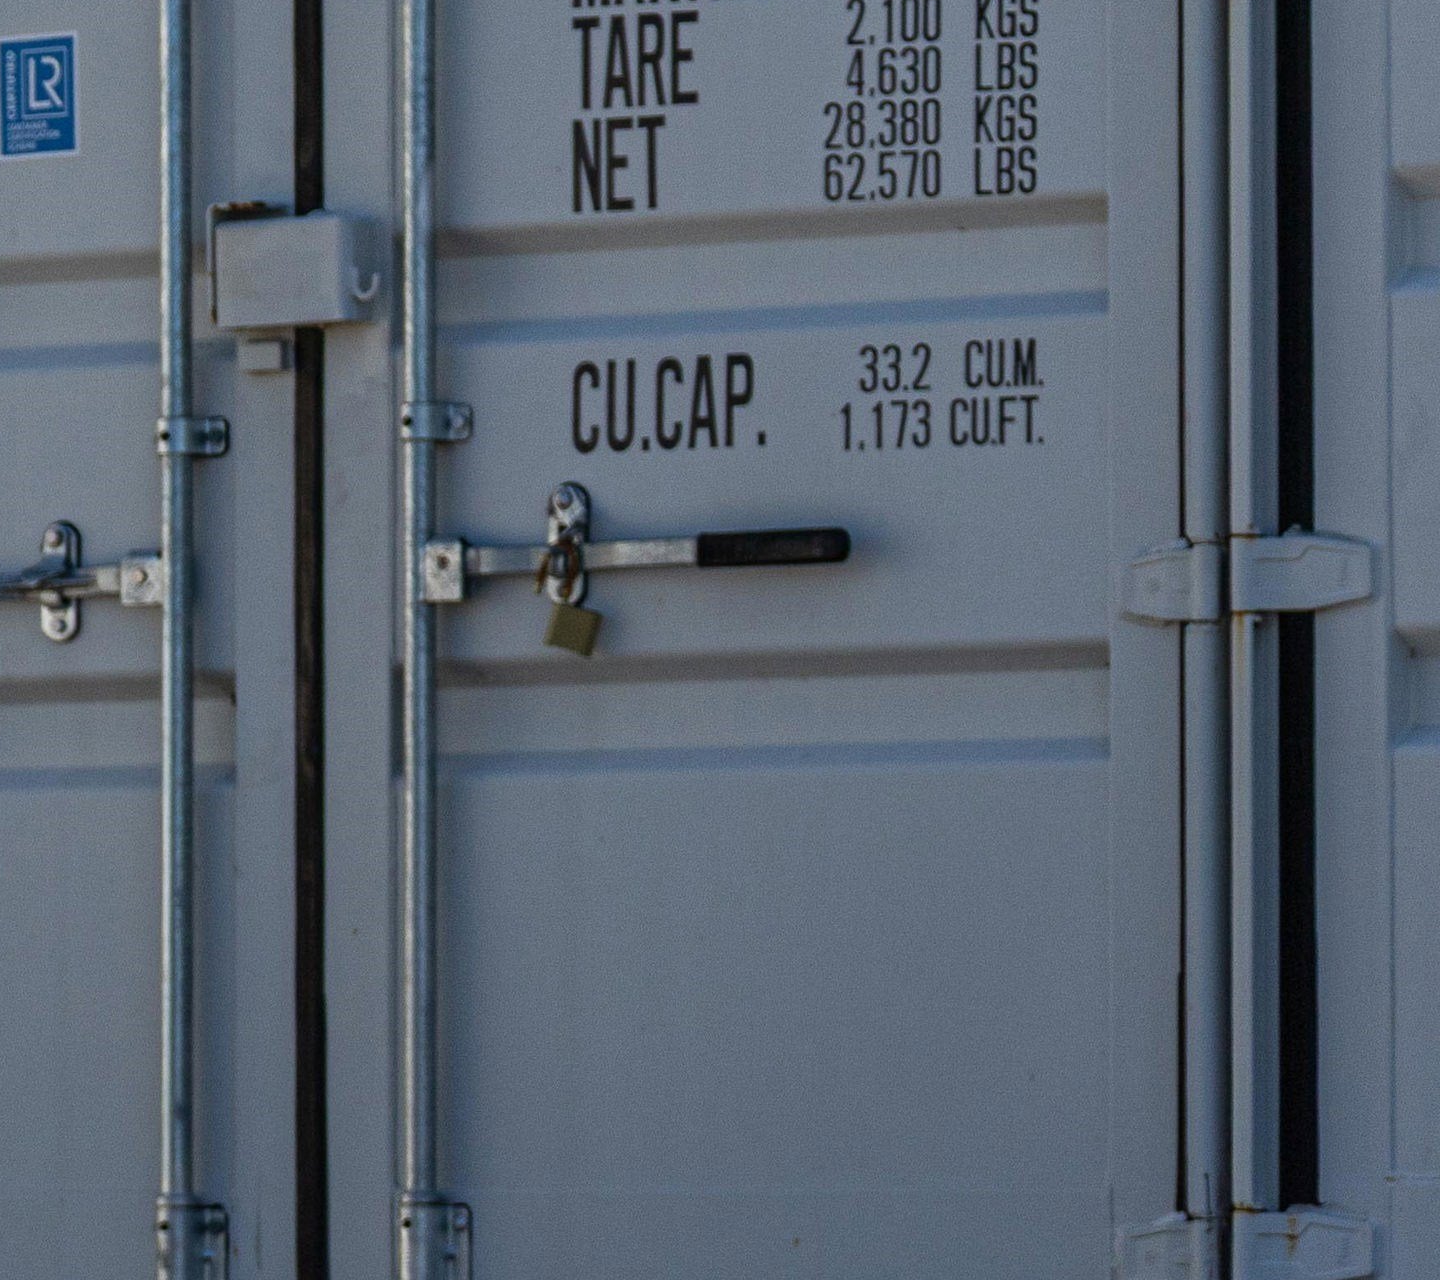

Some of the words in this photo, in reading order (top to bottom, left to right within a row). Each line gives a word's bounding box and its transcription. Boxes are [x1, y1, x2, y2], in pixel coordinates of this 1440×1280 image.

[27, 54, 65, 111] LR
[572, 10, 700, 110] TARE
[974, 41, 1039, 91] LBS
[974, 93, 1038, 143] KGS
[571, 115, 667, 214] NET
[974, 145, 1038, 195] LBS
[859, 342, 932, 393] 33.2
[964, 337, 1045, 388] CU.M.
[572, 353, 768, 454] CU.CAP.
